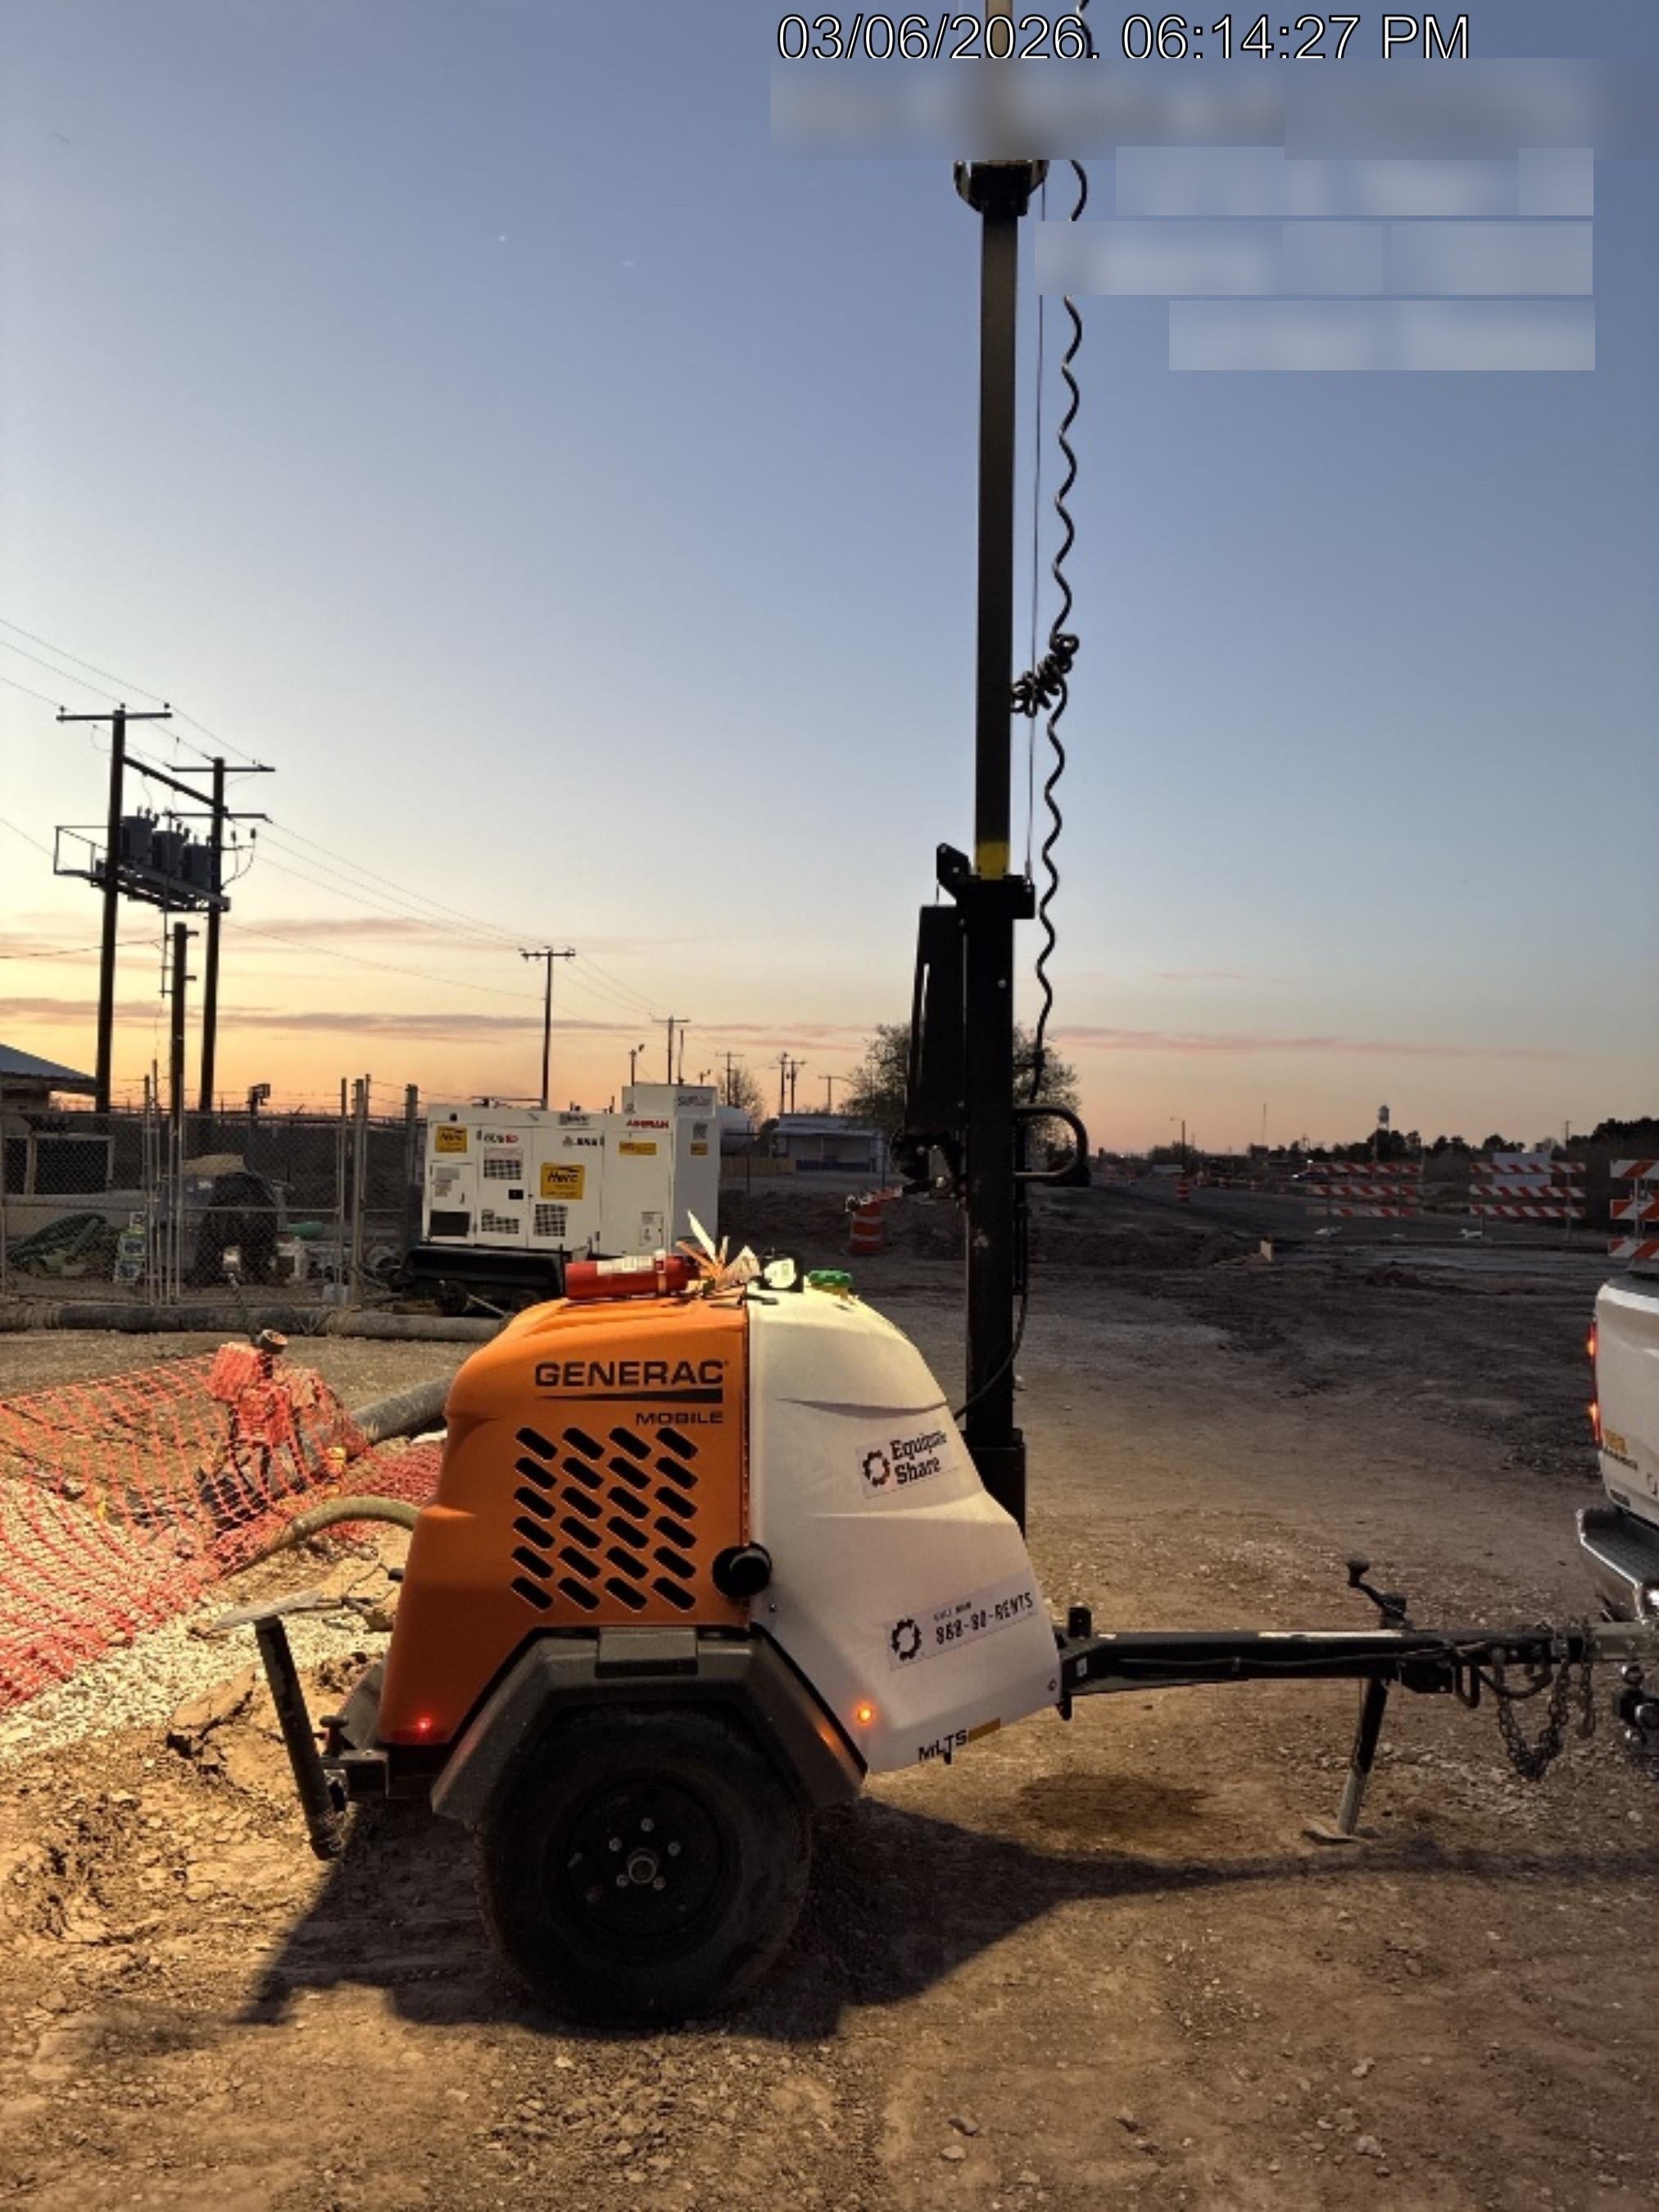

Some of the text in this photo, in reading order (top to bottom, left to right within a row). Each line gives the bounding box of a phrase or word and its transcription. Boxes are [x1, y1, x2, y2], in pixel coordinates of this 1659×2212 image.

[534, 1359, 723, 1387] GENERAC
[635, 1412, 723, 1426] MOBILE
[894, 1457, 941, 1485] Share
